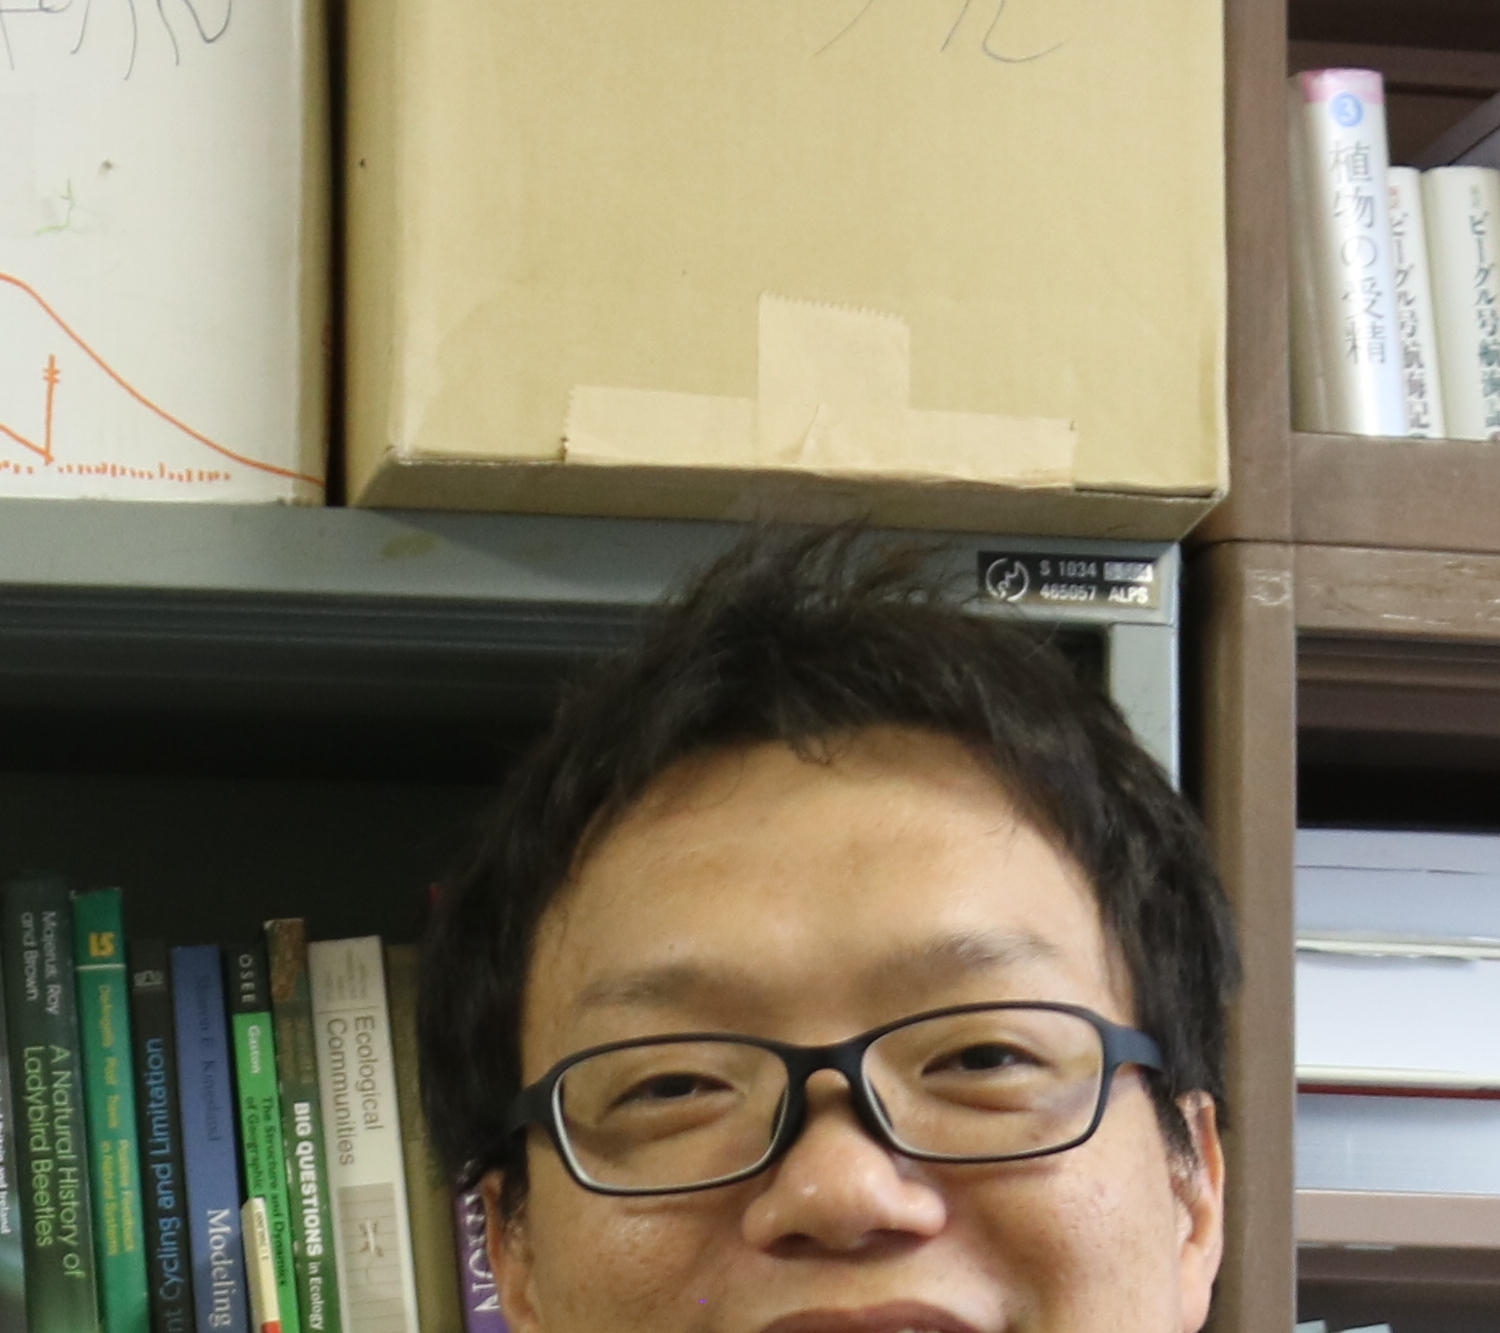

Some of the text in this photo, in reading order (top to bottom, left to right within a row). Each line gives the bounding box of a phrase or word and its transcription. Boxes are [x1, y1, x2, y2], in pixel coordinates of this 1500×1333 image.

[1327, 139, 1389, 366] 植物の受精
[1040, 560, 1096, 577] S 1034
[1040, 584, 1148, 603] 465057 ALPS
[23, 1046, 51, 1149] Ladybird
[145, 1037, 168, 1156] Limitation
[246, 1024, 262, 1074] Gaston
[325, 1015, 356, 1167] Communities
[353, 1014, 383, 1131] Ecological
[52, 1070, 73, 1152] Natural
[293, 1102, 323, 1257] BIG QUESTIONS
[204, 1208, 237, 1328] Modeling
